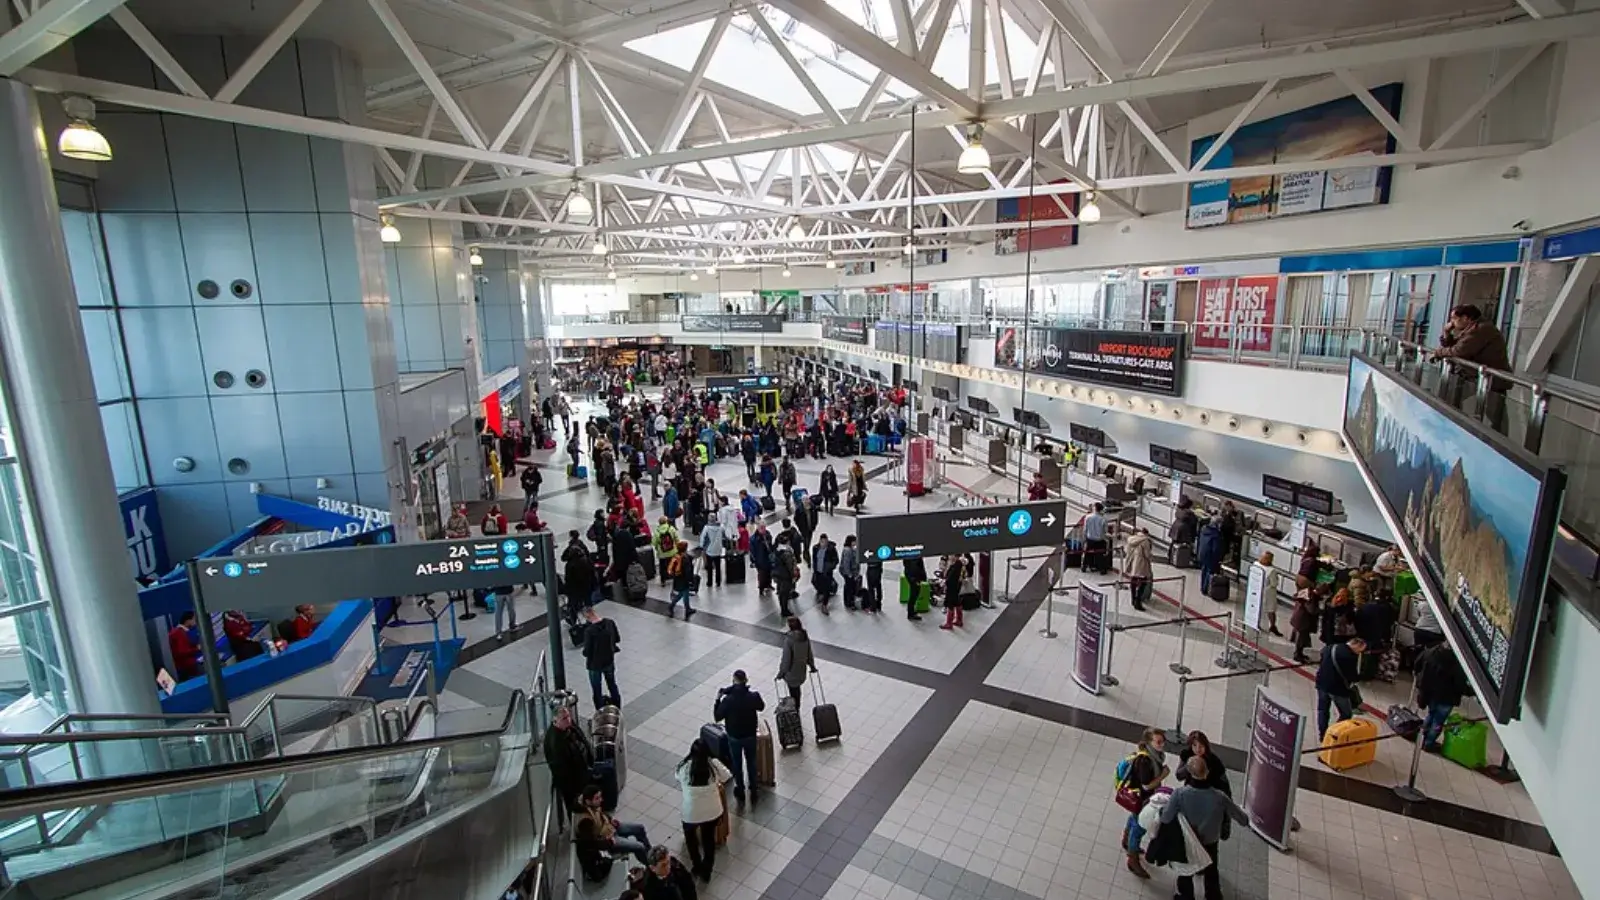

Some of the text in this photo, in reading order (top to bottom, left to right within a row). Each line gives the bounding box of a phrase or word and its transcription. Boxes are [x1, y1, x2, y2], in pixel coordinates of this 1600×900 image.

[951, 516, 999, 528] Utasfelvétel
[963, 527, 999, 538] Check-in
[449, 545, 469, 558] 2A
